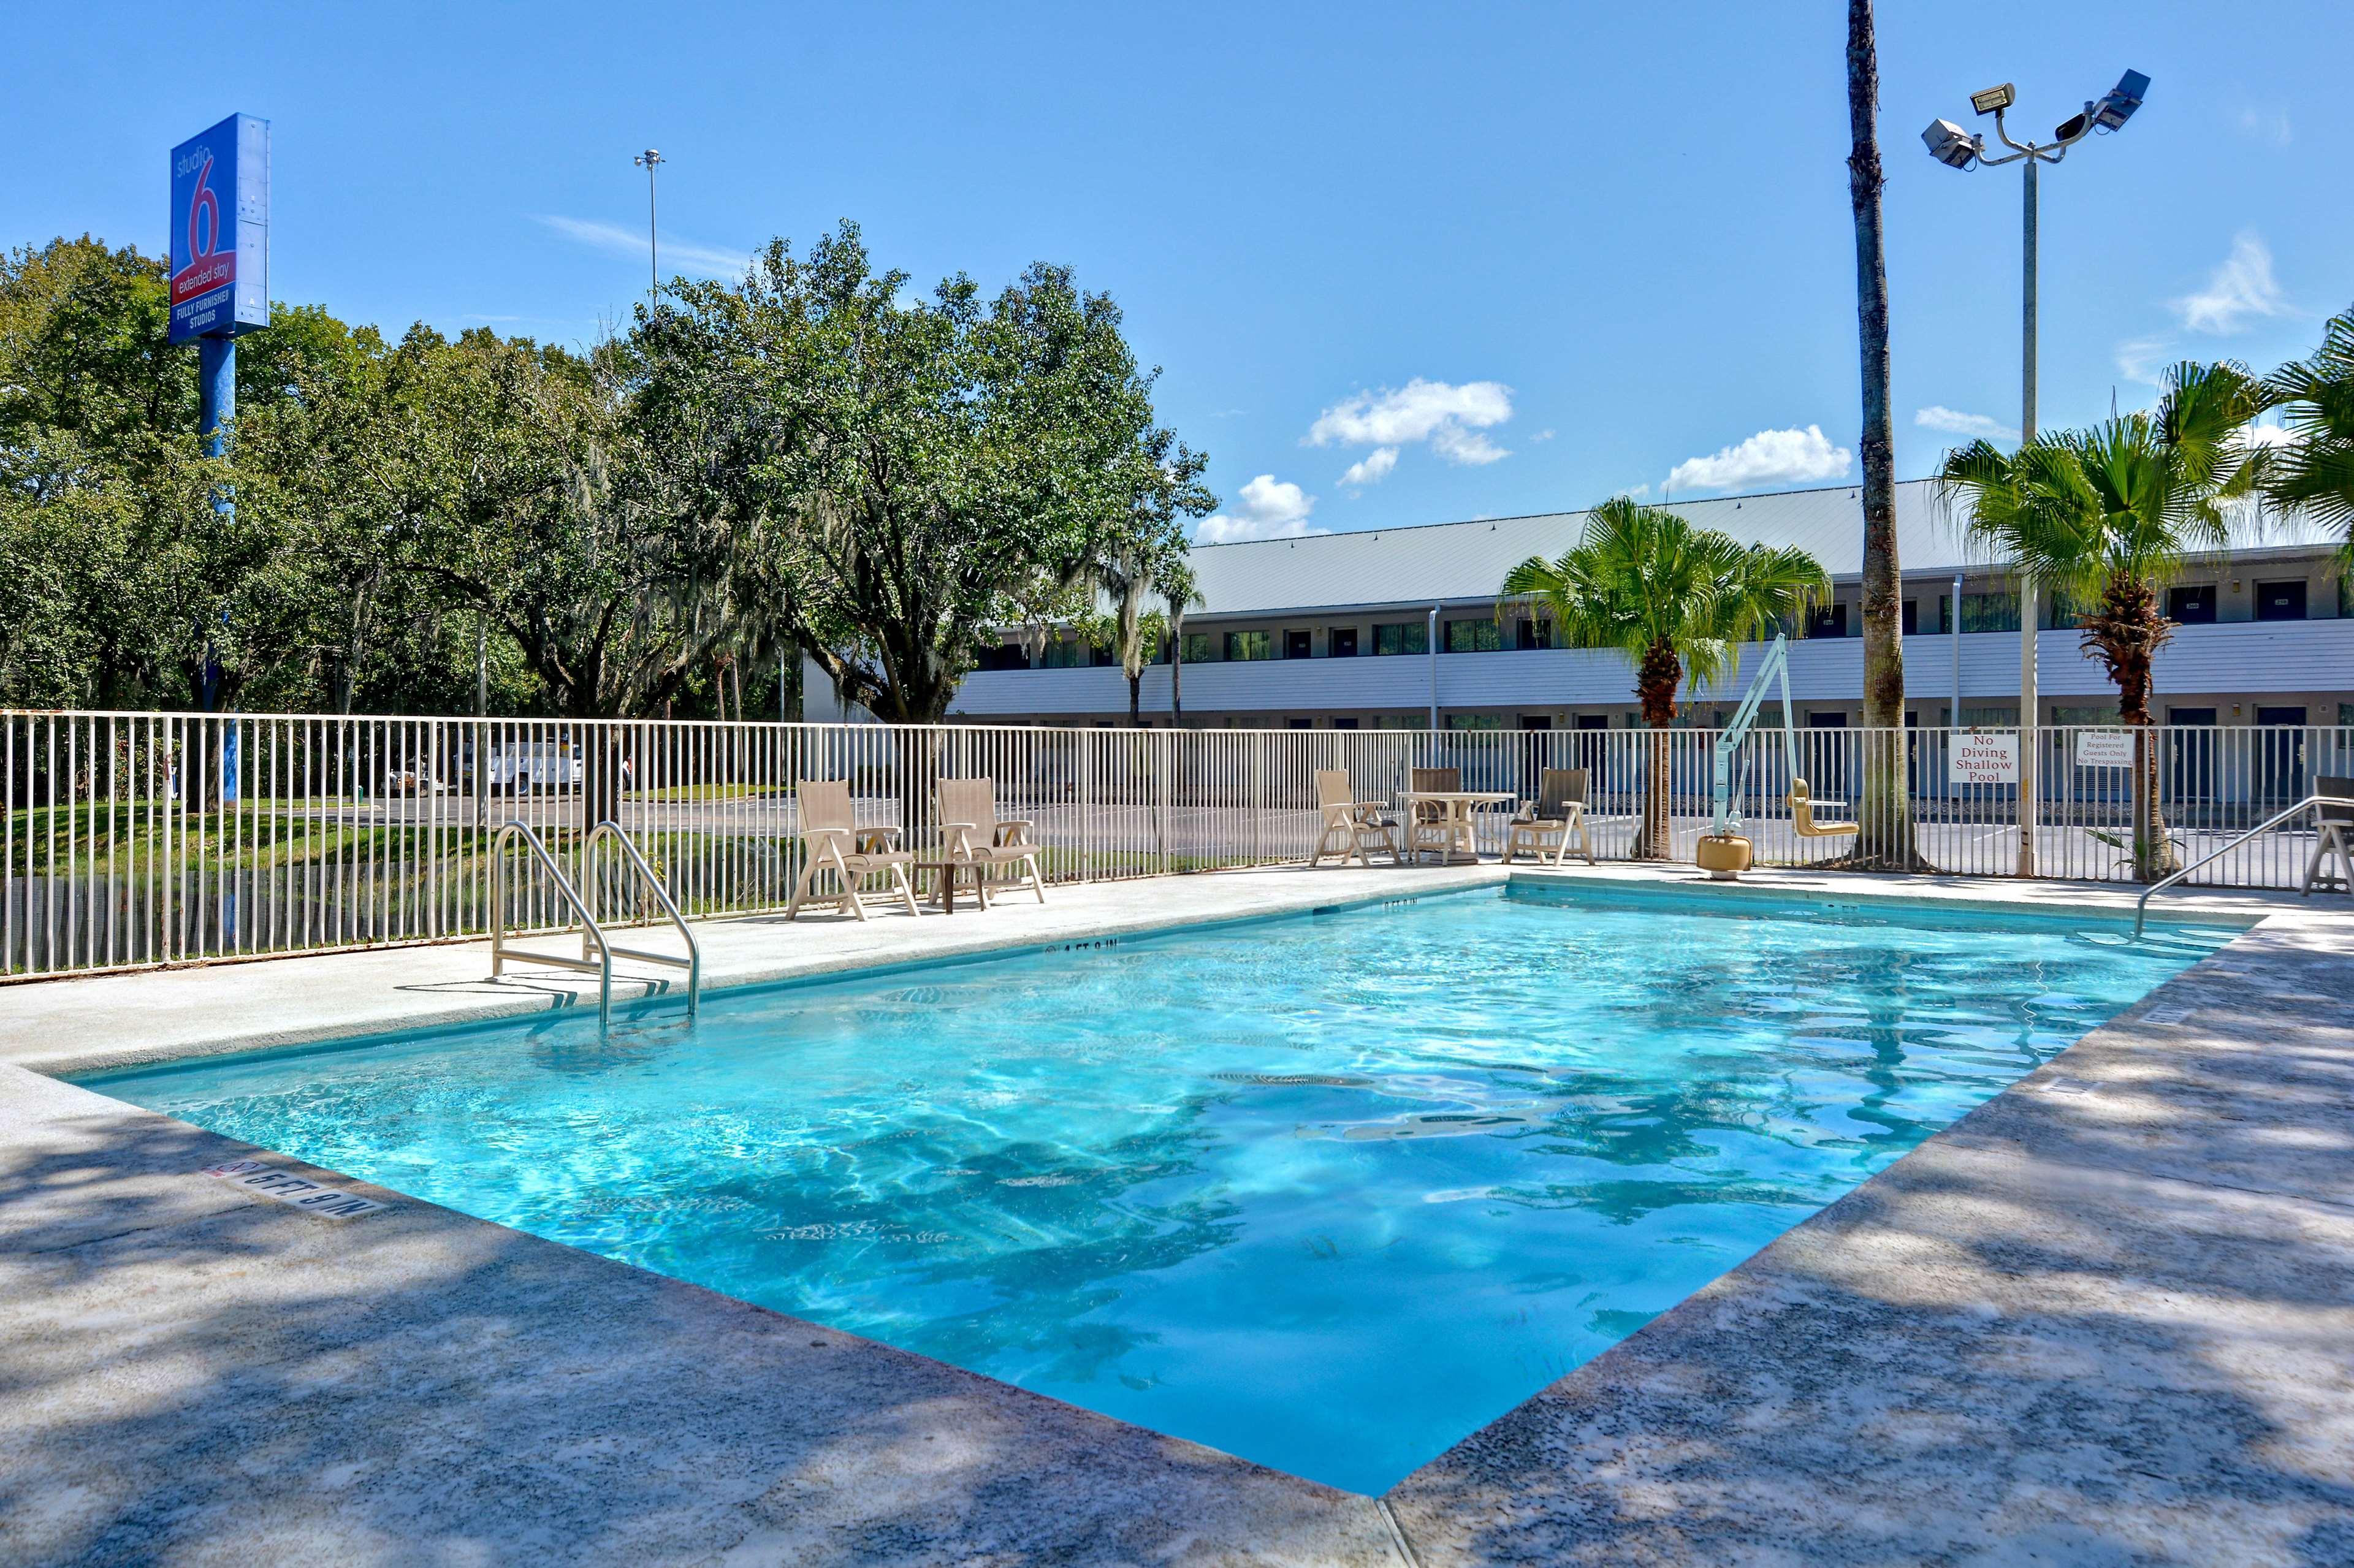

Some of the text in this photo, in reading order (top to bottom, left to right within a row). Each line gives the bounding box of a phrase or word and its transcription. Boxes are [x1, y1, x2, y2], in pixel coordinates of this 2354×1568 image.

[177, 145, 210, 178] studio
[189, 154, 219, 263] 6
[180, 261, 229, 294] extended stay
[177, 289, 229, 320] FULLY FURNISHED
[190, 309, 216, 329] STUDIOS
[1974, 736, 1994, 745] No
[1962, 748, 2007, 759] Diving
[1956, 760, 2012, 770] Shallow
[1968, 772, 1999, 782] Pool
[244, 1173, 287, 1184] 5
